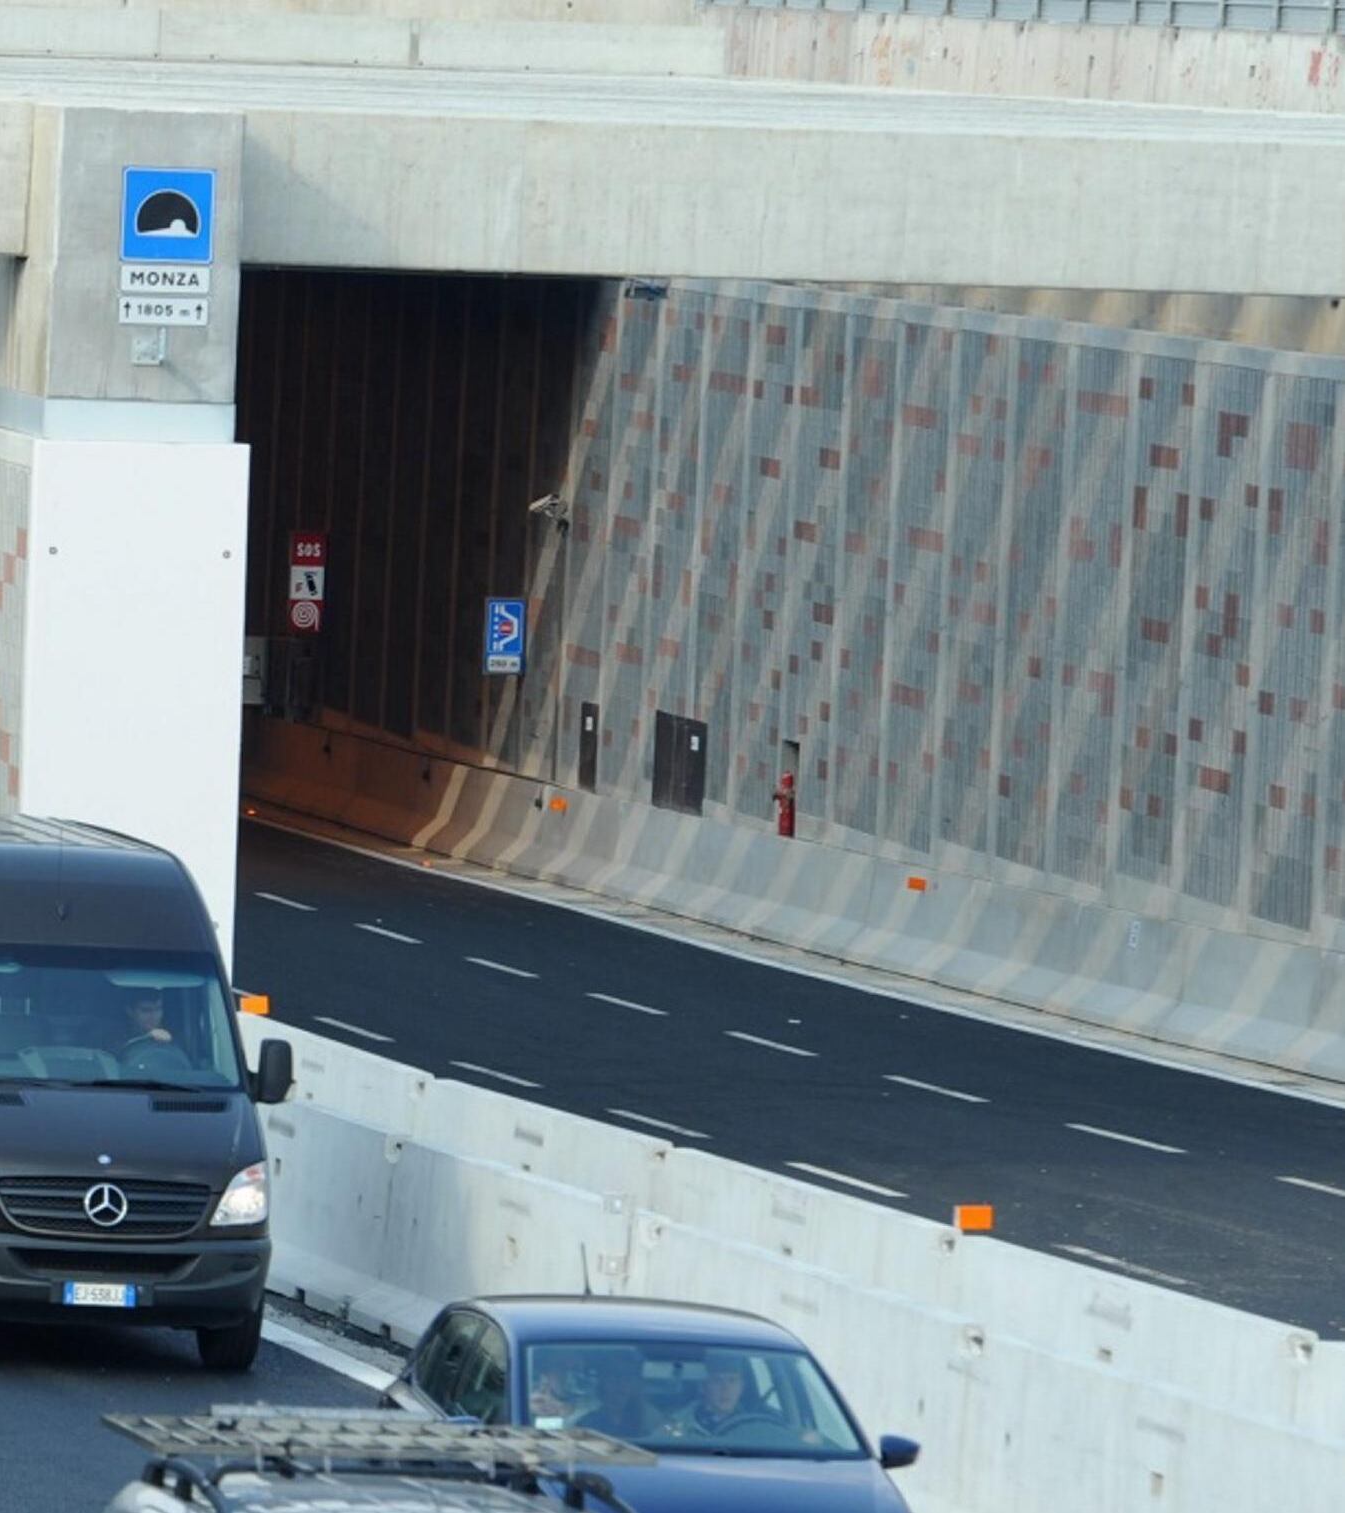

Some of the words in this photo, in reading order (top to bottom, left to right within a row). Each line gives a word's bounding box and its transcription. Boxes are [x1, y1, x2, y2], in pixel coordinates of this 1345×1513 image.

[130, 271, 200, 287] MONZA
[137, 304, 173, 317] 1805
[297, 542, 321, 557] SOS
